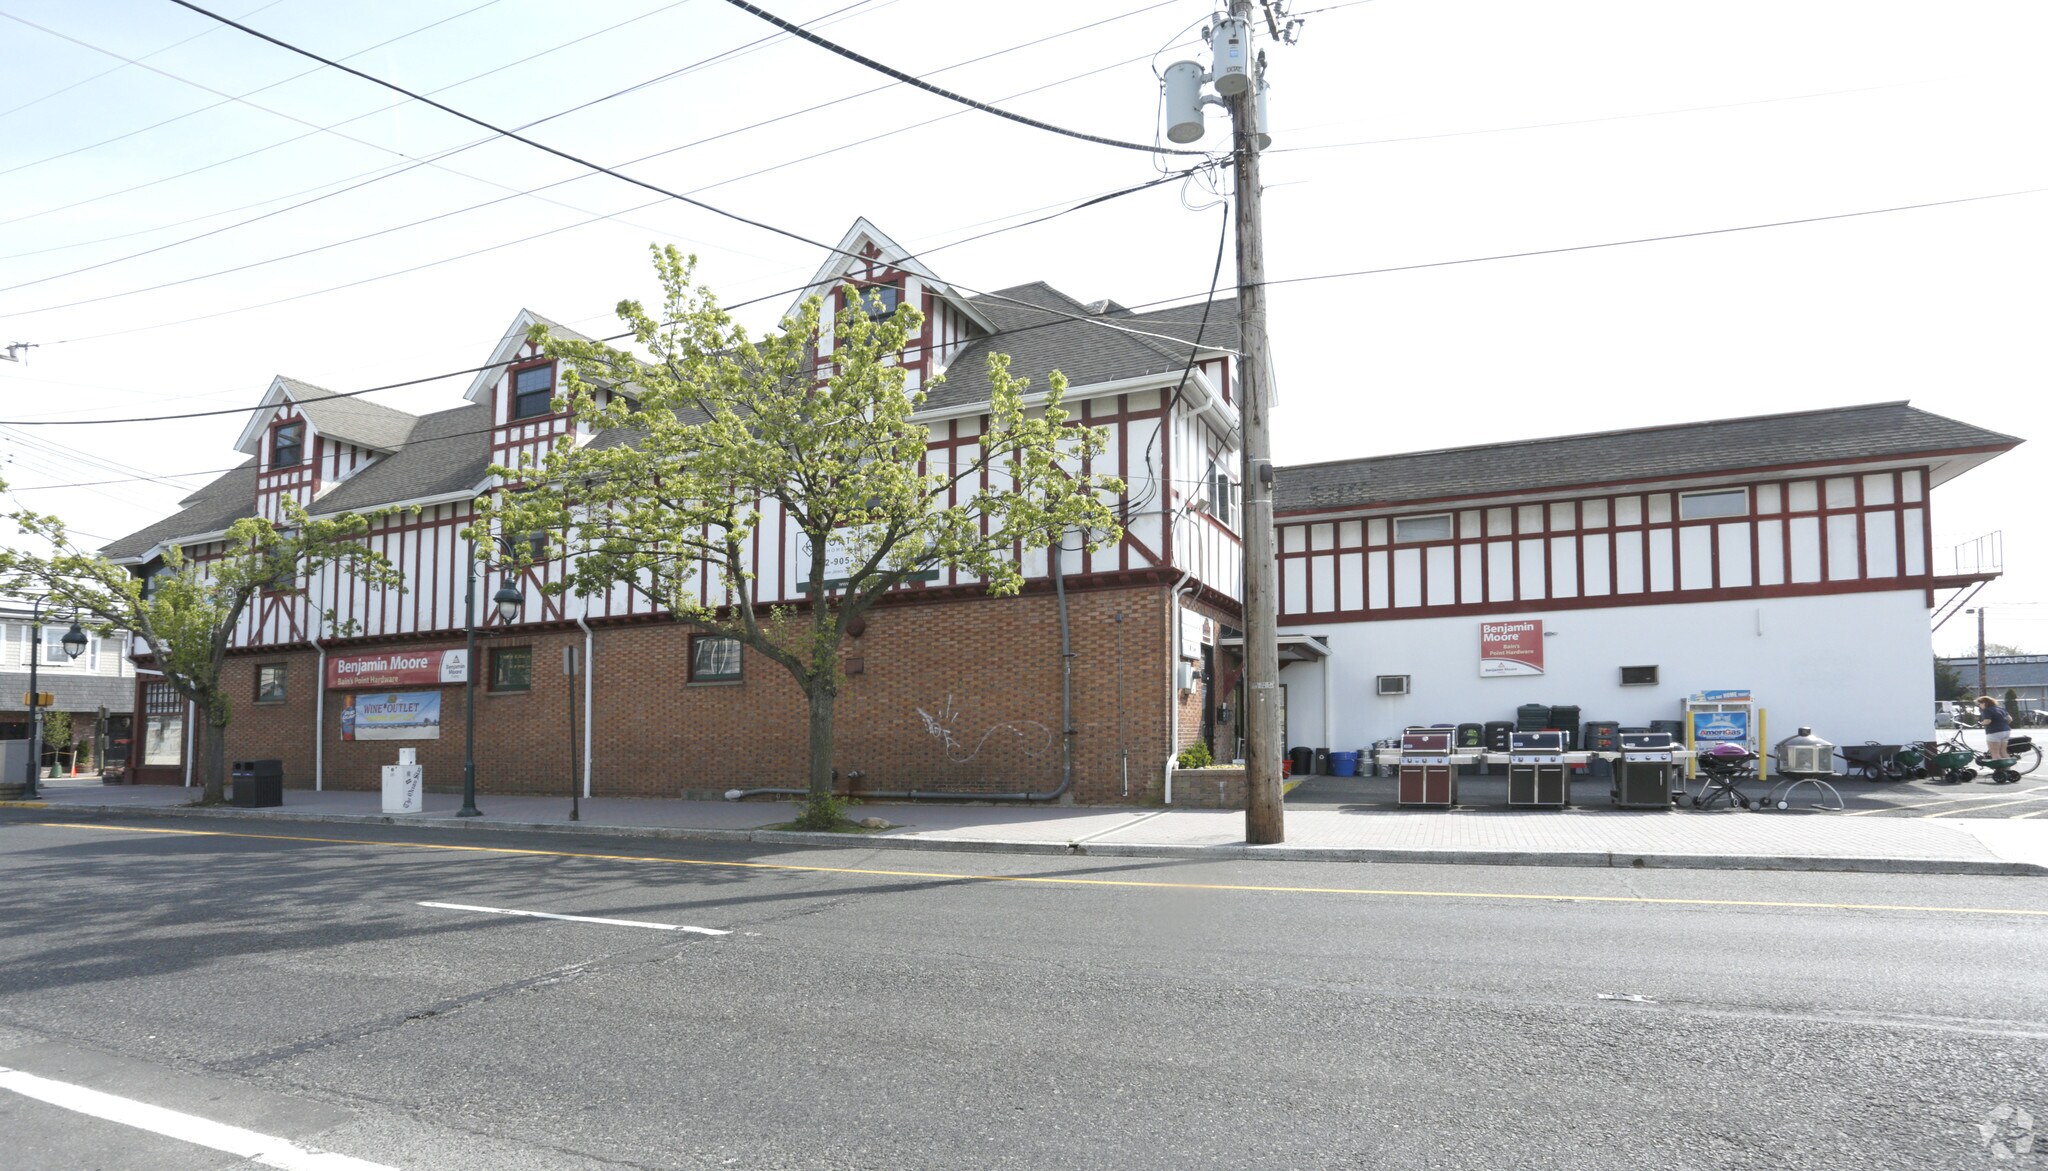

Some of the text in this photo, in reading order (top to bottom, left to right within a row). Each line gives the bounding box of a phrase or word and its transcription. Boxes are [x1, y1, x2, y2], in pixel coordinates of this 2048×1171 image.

[1483, 622, 1534, 634] Benjamin
[1483, 633, 1519, 642] Moore
[338, 656, 428, 676] Benjamin Moore
[370, 675, 398, 683] Hardware
[364, 703, 419, 714] WINE OUTLET
